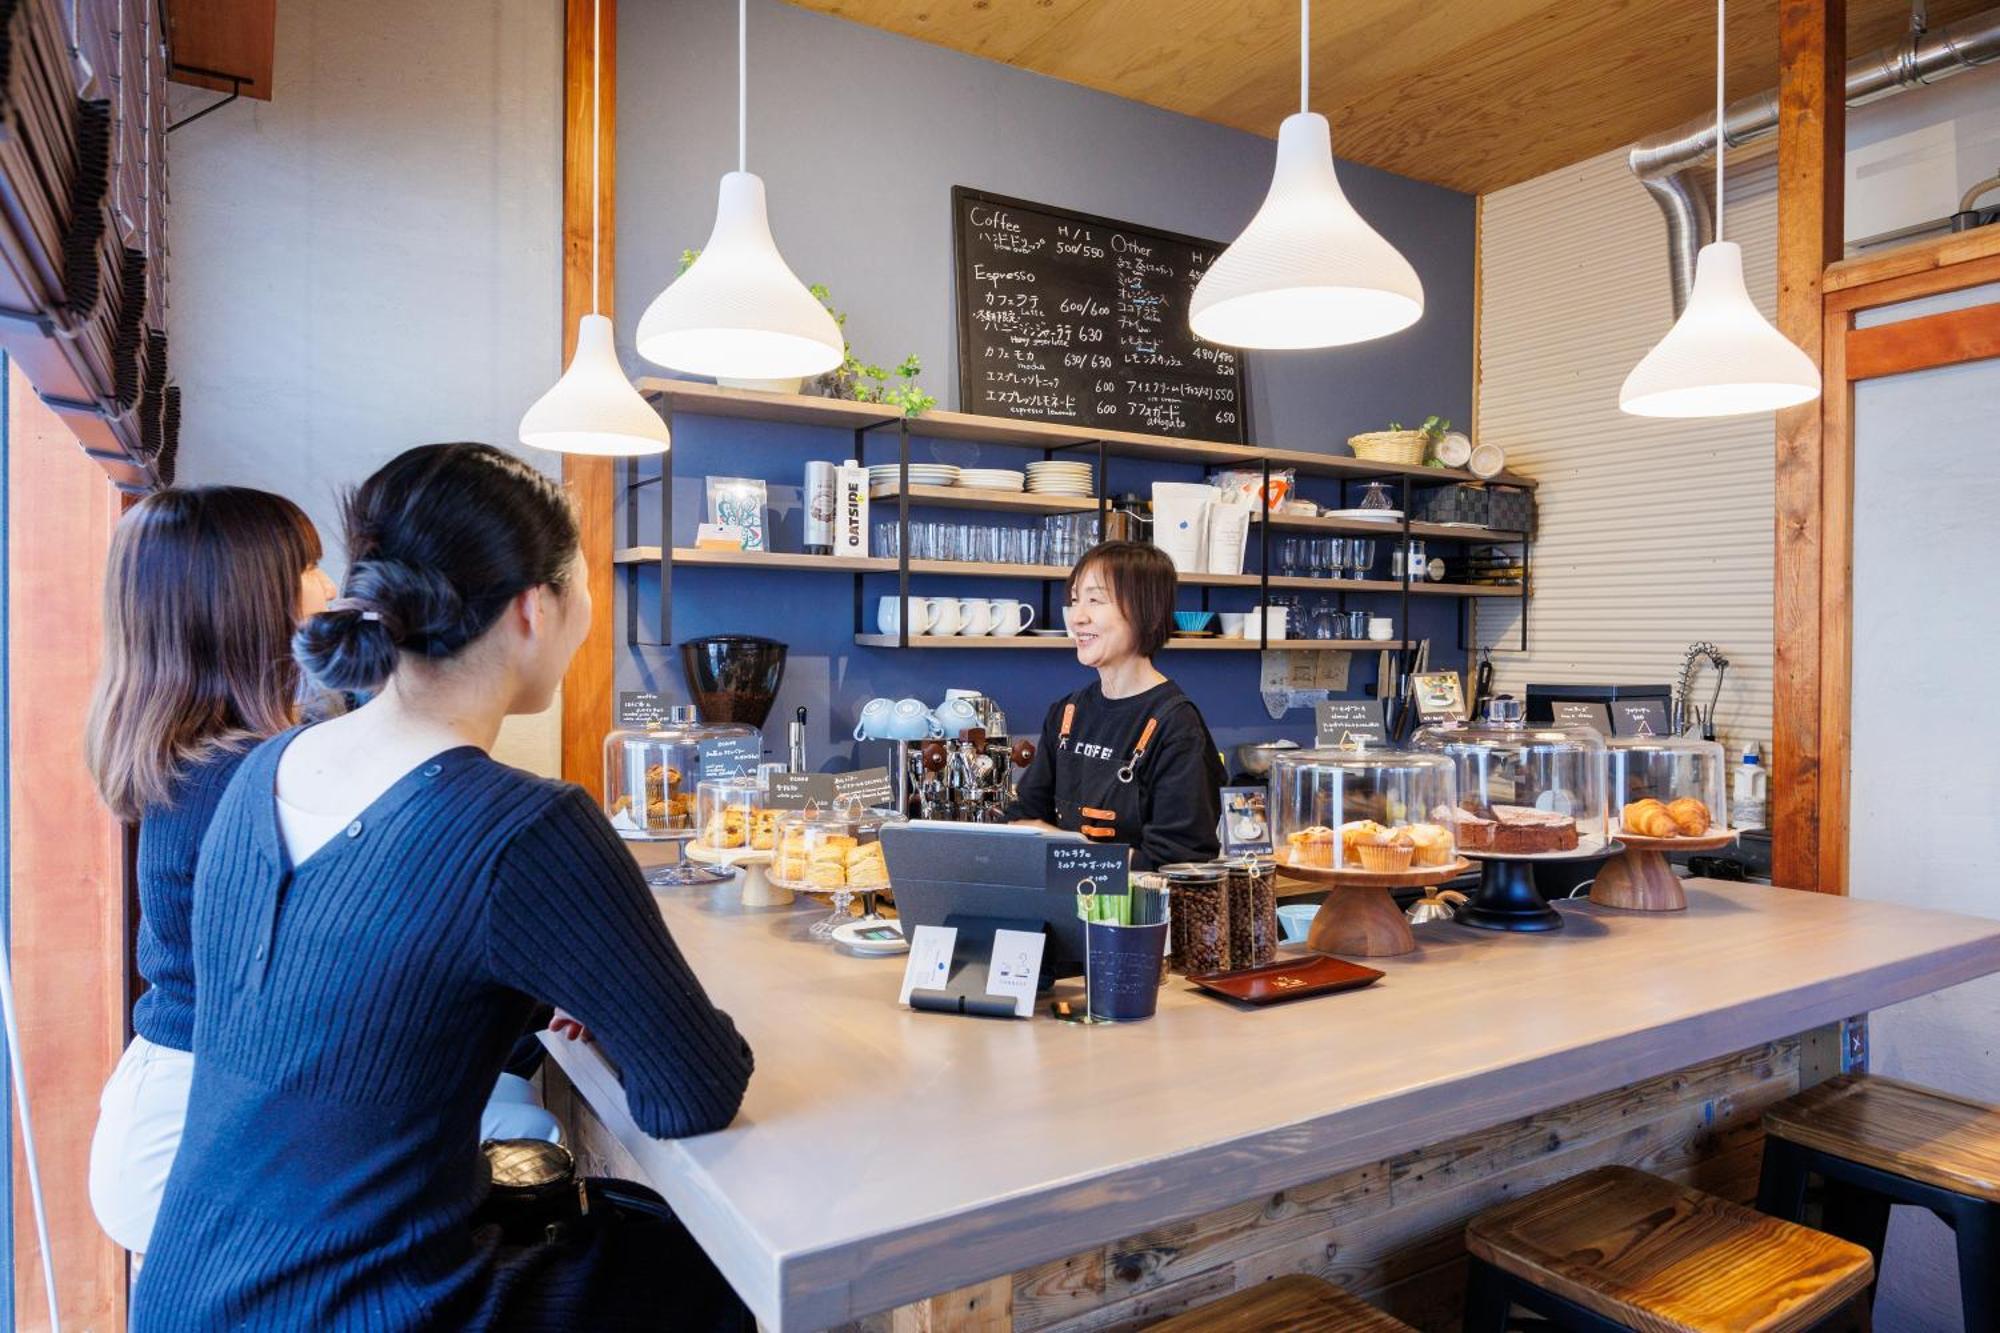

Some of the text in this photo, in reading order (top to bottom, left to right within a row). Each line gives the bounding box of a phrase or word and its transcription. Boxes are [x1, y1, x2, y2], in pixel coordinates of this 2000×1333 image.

[970, 206, 1021, 233] Coffee
[979, 232, 1105, 258] ハンドドリップ 500/550
[1111, 234, 1153, 256] Other
[974, 264, 1036, 288] Espresso
[985, 291, 1110, 316] カフェラテ 600/600
[1079, 326, 1103, 342] 630
[1064, 352, 1112, 369] 630/630
[1216, 363, 1235, 376] 520
[1095, 379, 1116, 393] 600
[1214, 389, 1235, 402] 550
[1096, 400, 1118, 415] 600
[1215, 411, 1236, 424] 650
[848, 482, 860, 547] OATSIDE
